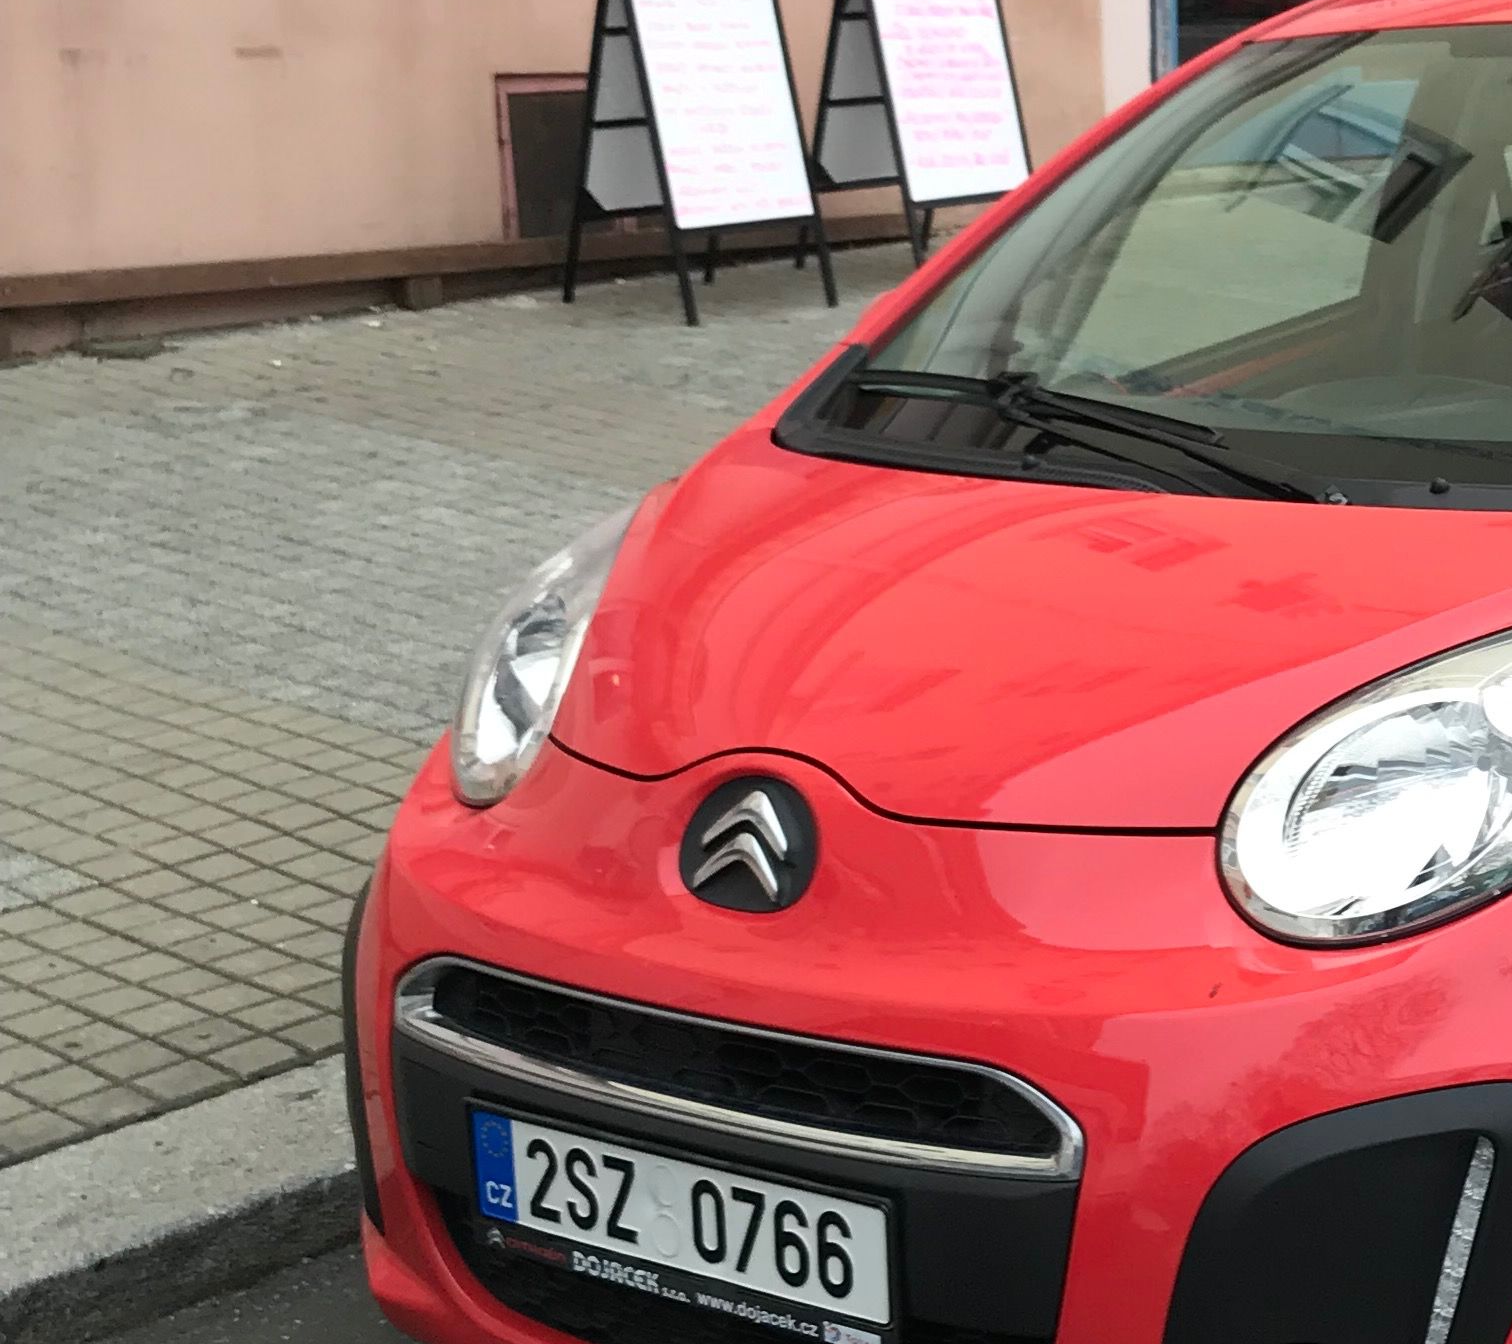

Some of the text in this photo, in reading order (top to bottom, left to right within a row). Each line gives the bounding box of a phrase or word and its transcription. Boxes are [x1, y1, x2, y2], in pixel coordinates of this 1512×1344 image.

[486, 1180, 513, 1209] CZ
[526, 1138, 853, 1299] 2SZ 0766
[696, 1292, 819, 1337] www.dojacek.cz
